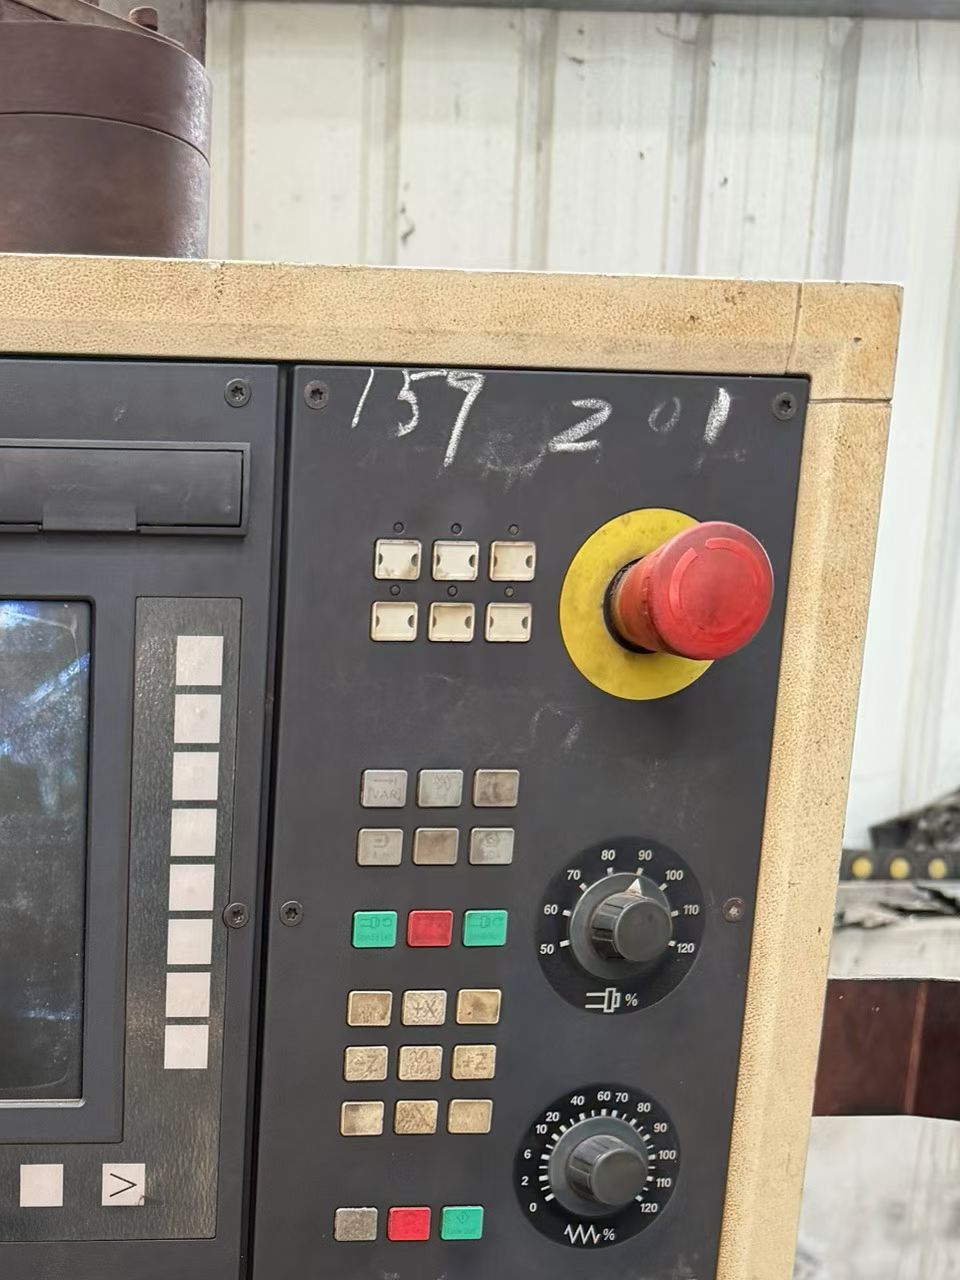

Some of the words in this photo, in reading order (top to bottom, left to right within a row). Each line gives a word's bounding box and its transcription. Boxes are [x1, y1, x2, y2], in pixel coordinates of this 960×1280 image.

[600, 850, 616, 861] 80
[638, 850, 653, 861] 90
[566, 870, 581, 880] 70
[665, 870, 684, 881] 100
[543, 904, 558, 915] 60
[682, 904, 700, 915] 110
[540, 944, 555, 955] 50
[676, 943, 695, 954] 120
[625, 993, 638, 1007] %
[570, 1095, 585, 1106] 40
[597, 1091, 611, 1101] 60
[615, 1092, 629, 1103] 70
[637, 1103, 651, 1113] 80
[545, 1112, 560, 1122] 20
[535, 1124, 547, 1134] 10
[653, 1122, 668, 1133] 90
[524, 1150, 531, 1159] 6
[658, 1150, 676, 1160] 100
[521, 1176, 529, 1186] 2
[656, 1178, 672, 1188] 110
[529, 1203, 537, 1213] 0
[640, 1203, 658, 1213] 120
[602, 1228, 615, 1241] %
